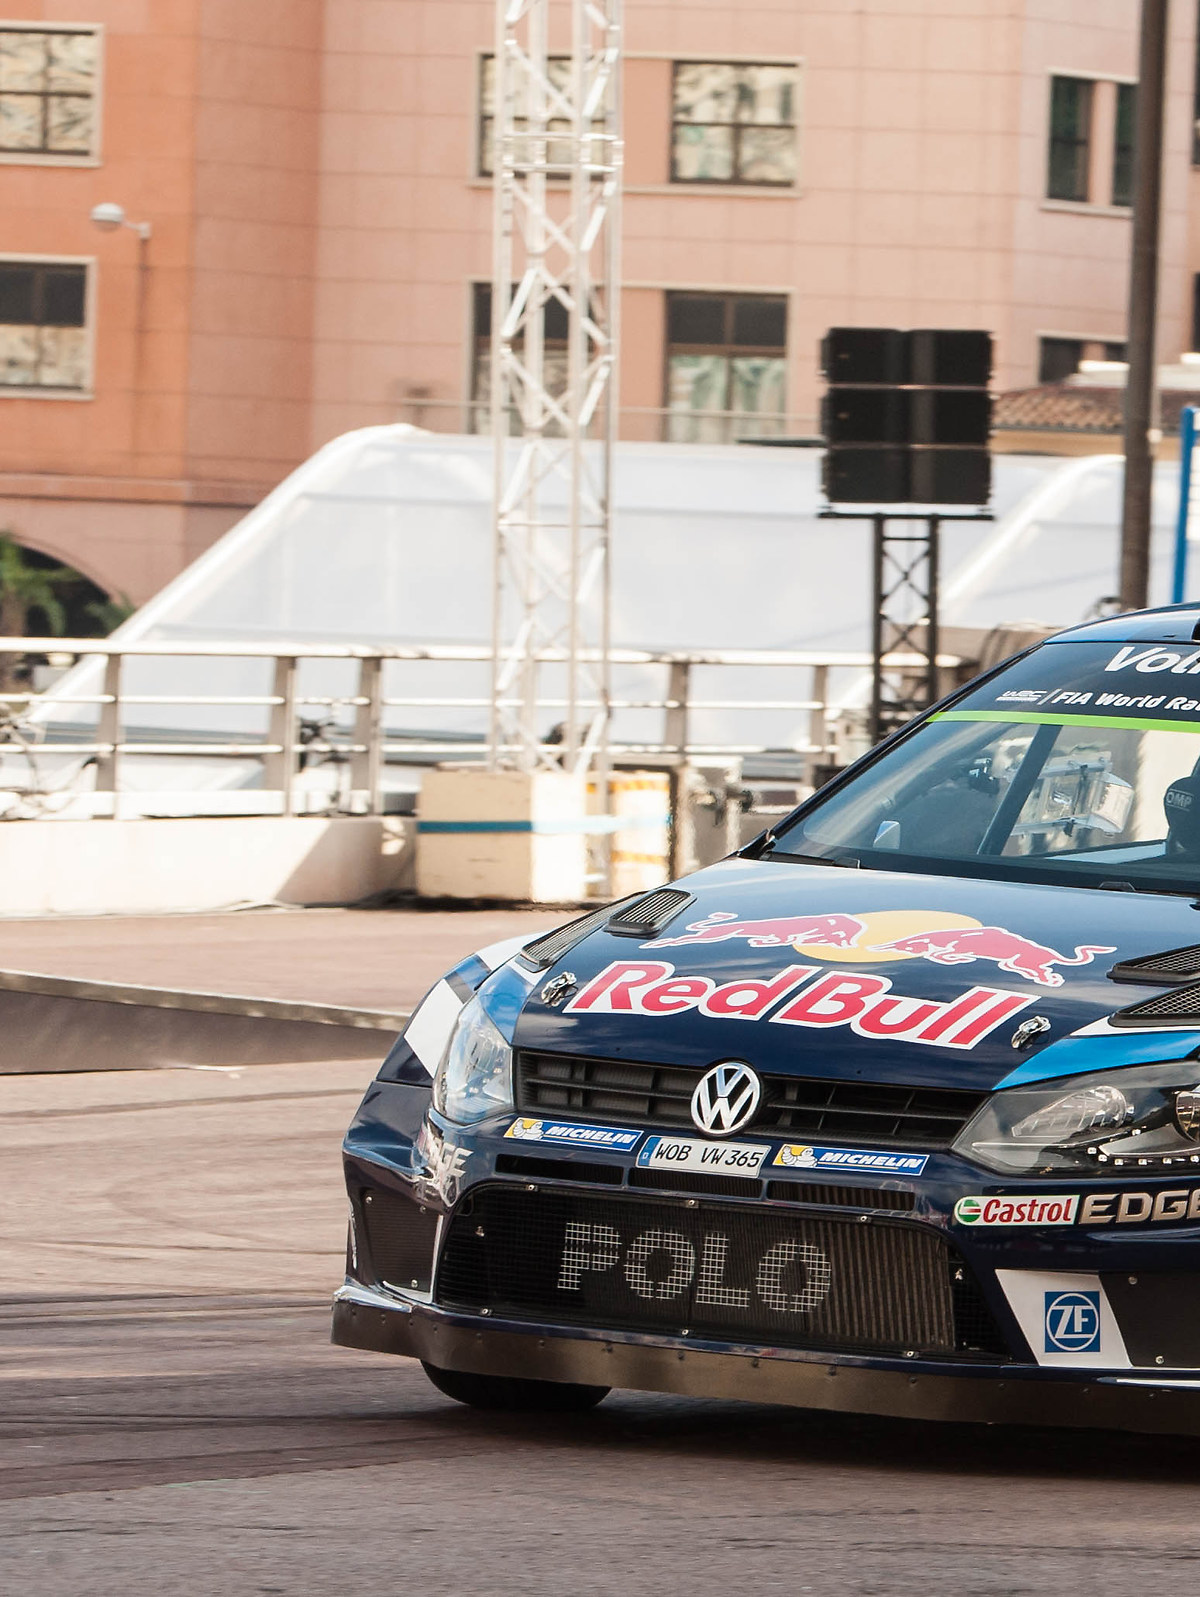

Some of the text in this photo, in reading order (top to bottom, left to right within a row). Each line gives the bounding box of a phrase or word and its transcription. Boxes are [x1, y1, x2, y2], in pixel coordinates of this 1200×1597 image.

[1051, 691, 1095, 706] FIA
[1095, 692, 1166, 709] World
[1166, 791, 1192, 808] OMP
[566, 962, 1037, 1048] Red Bull
[545, 1126, 637, 1144] MICHELIN
[655, 1143, 764, 1168] WOB VW 365
[820, 1152, 923, 1169] MICHELIN
[983, 1198, 1073, 1224] Castrol
[557, 1221, 832, 1313] POLO
